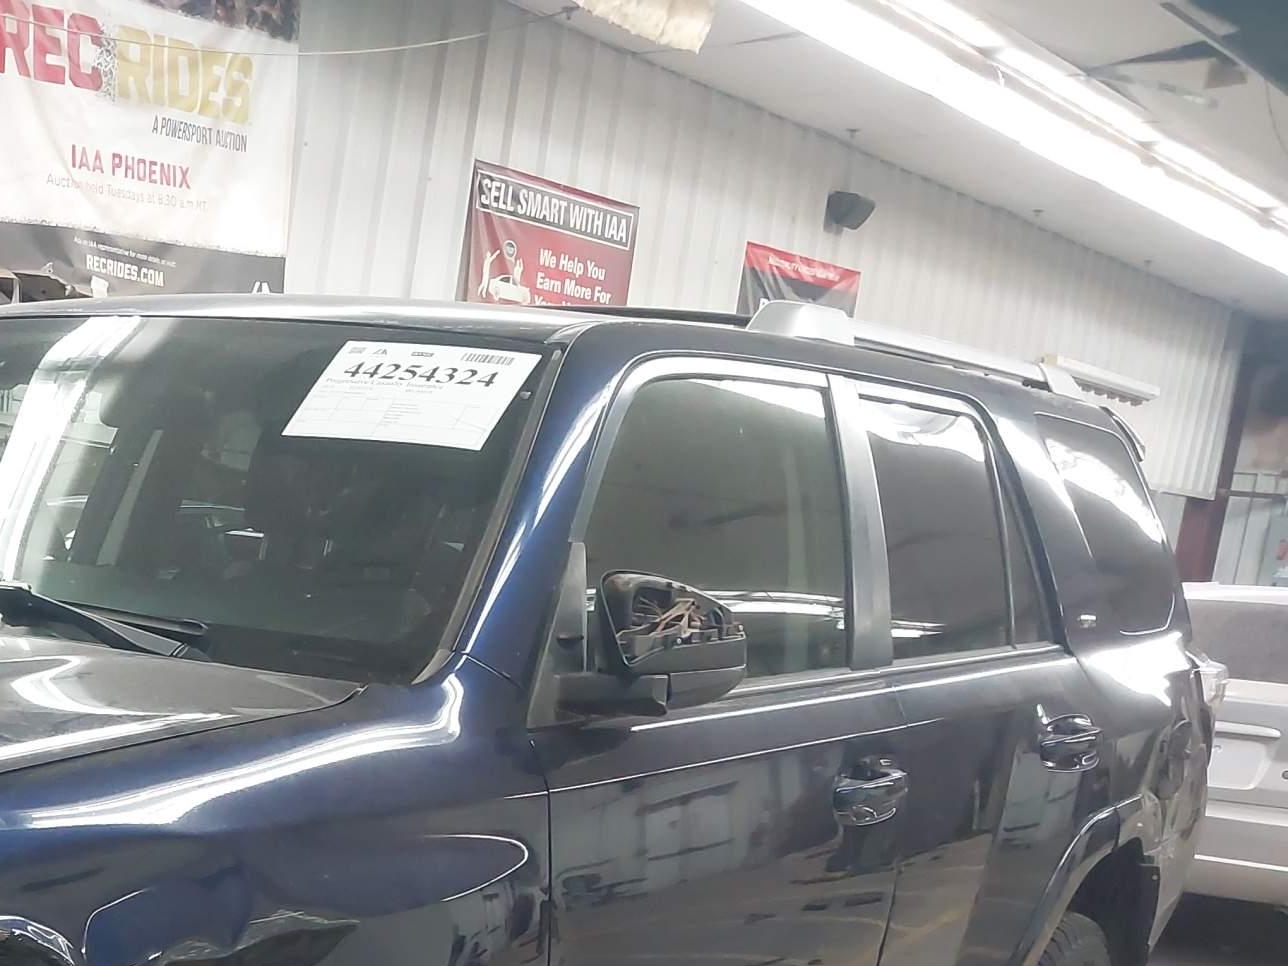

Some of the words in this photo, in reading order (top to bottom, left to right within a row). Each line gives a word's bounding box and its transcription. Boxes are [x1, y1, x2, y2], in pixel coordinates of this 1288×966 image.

[117, 24, 253, 125] RIDES
[152, 115, 159, 134] A
[160, 117, 213, 145] POWERSPORT
[215, 129, 248, 153] AUCTION
[71, 143, 104, 174] IAA
[111, 152, 191, 189] PHOENIX
[480, 178, 514, 212] SELL
[517, 188, 568, 225] SMART
[569, 203, 604, 236] WITH
[604, 215, 627, 243] IAA
[86, 254, 164, 287] RECRIDES.COM
[539, 248, 557, 268] We
[559, 253, 584, 276] Help
[587, 260, 605, 281] You
[536, 272, 561, 294] Earn
[563, 278, 592, 300] More
[594, 286, 612, 305] For
[344, 361, 499, 388] 44254324
